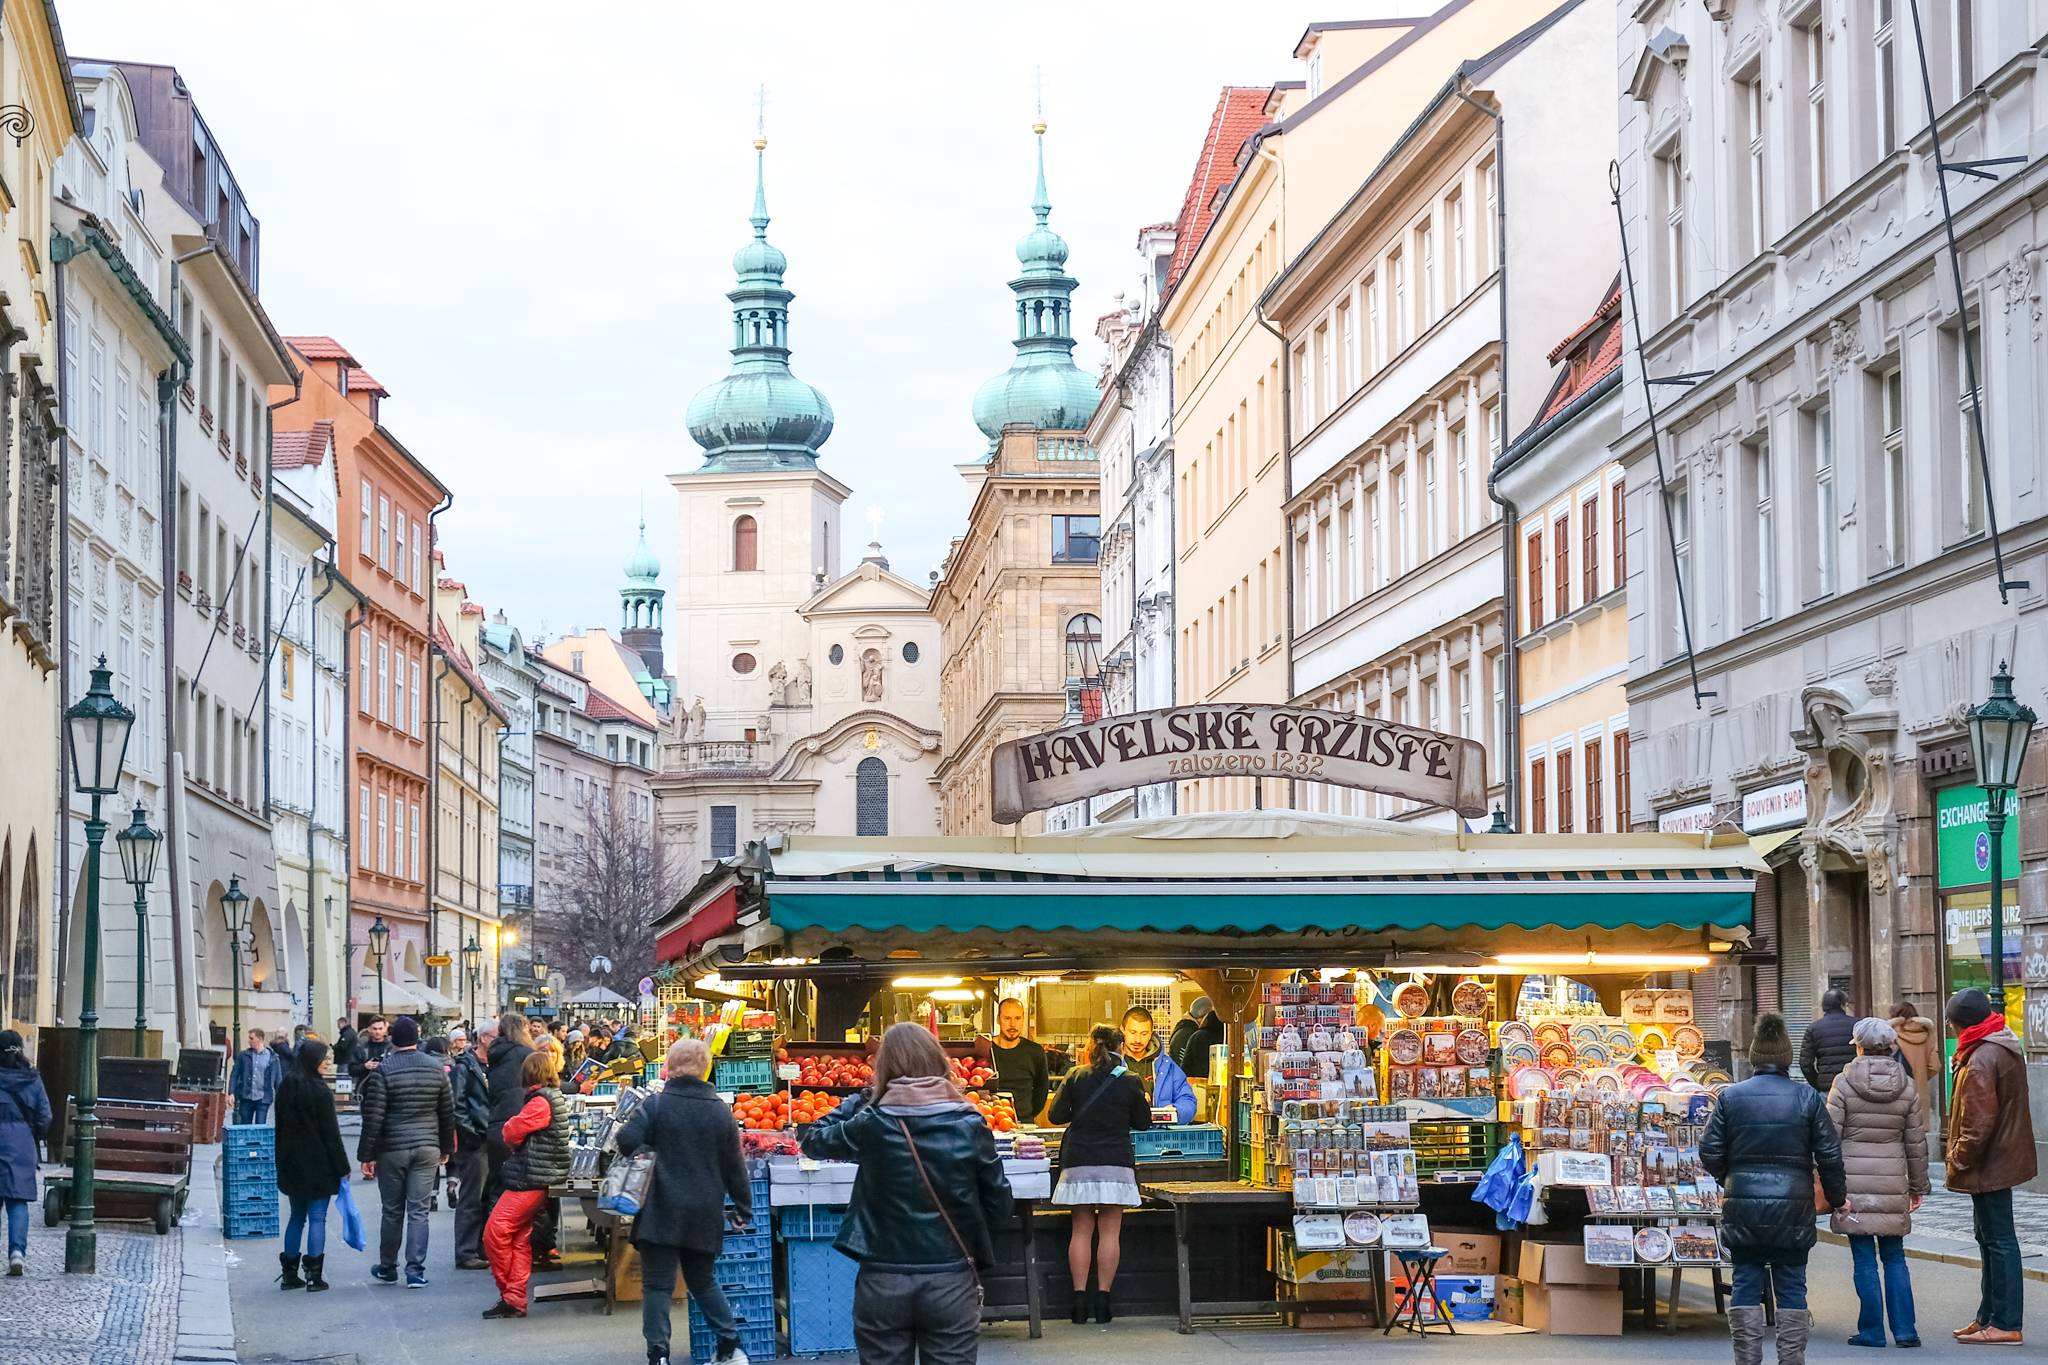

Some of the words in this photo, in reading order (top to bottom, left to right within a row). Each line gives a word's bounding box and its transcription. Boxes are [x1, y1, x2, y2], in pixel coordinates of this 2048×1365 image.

[1019, 705, 1261, 784] HAVELSKÉ
[1269, 713, 1455, 781] TRŽIŠTĚ
[1167, 752, 1266, 776] založeno
[1271, 752, 1325, 776] 1232
[1747, 795, 1782, 819] SOUVENIR
[1784, 789, 1803, 811] SHOP
[1940, 801, 1990, 829] EXCHANGE
[1958, 904, 1992, 931] NEJLEPŠ
[2001, 905, 2021, 924] URZ
